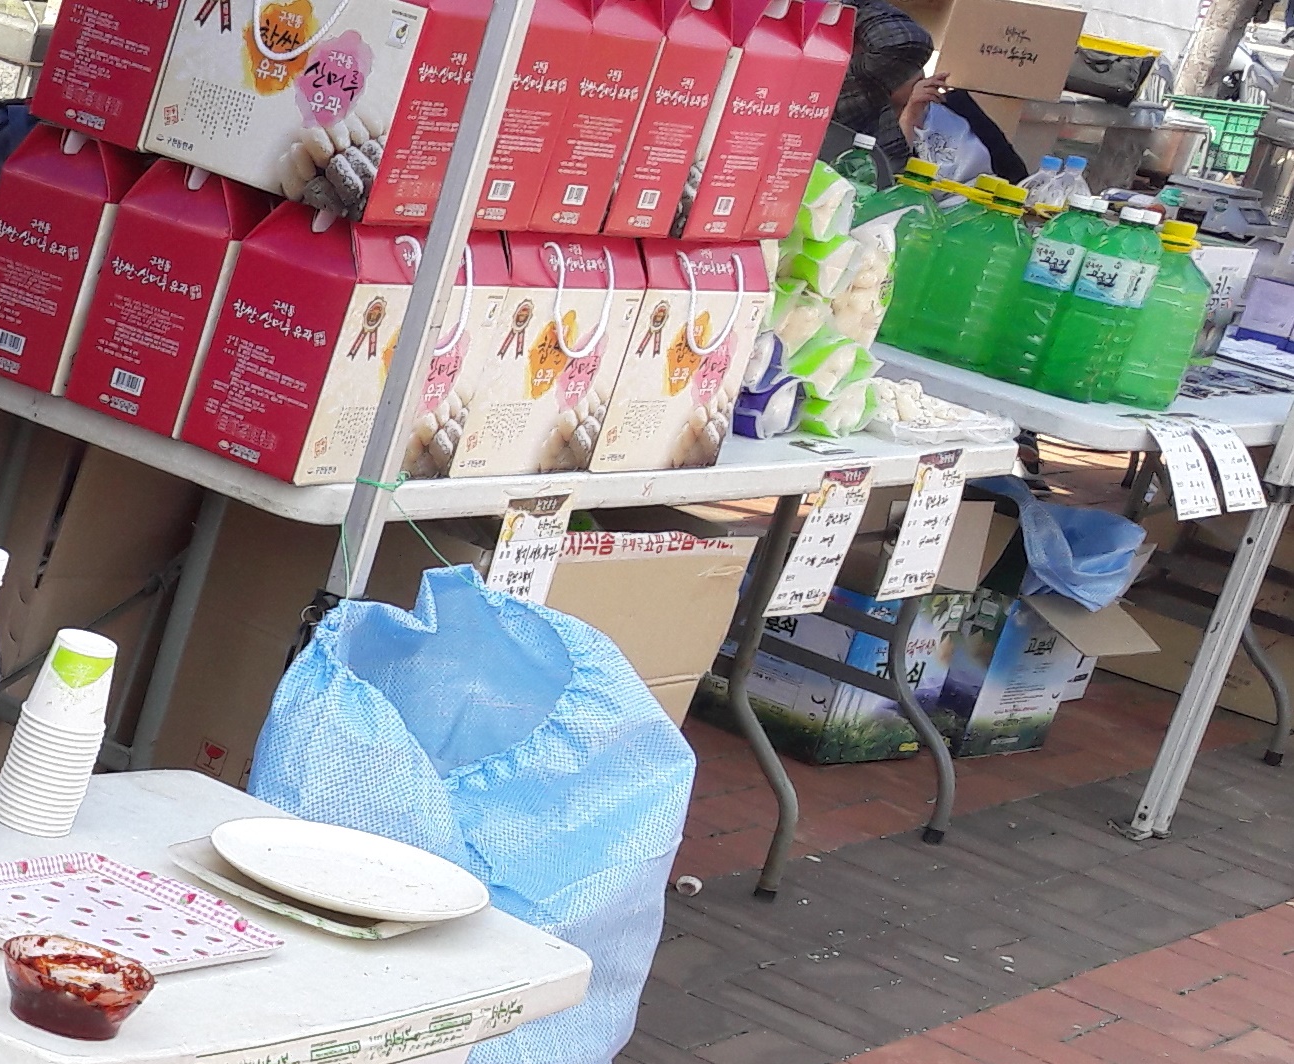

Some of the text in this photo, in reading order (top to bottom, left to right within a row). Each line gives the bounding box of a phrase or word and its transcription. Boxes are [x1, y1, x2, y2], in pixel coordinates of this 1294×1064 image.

[255, 60, 289, 82] 유과
[304, 61, 359, 101] 산머루
[309, 91, 342, 117] 유과
[559, 531, 615, 557] 지직송
